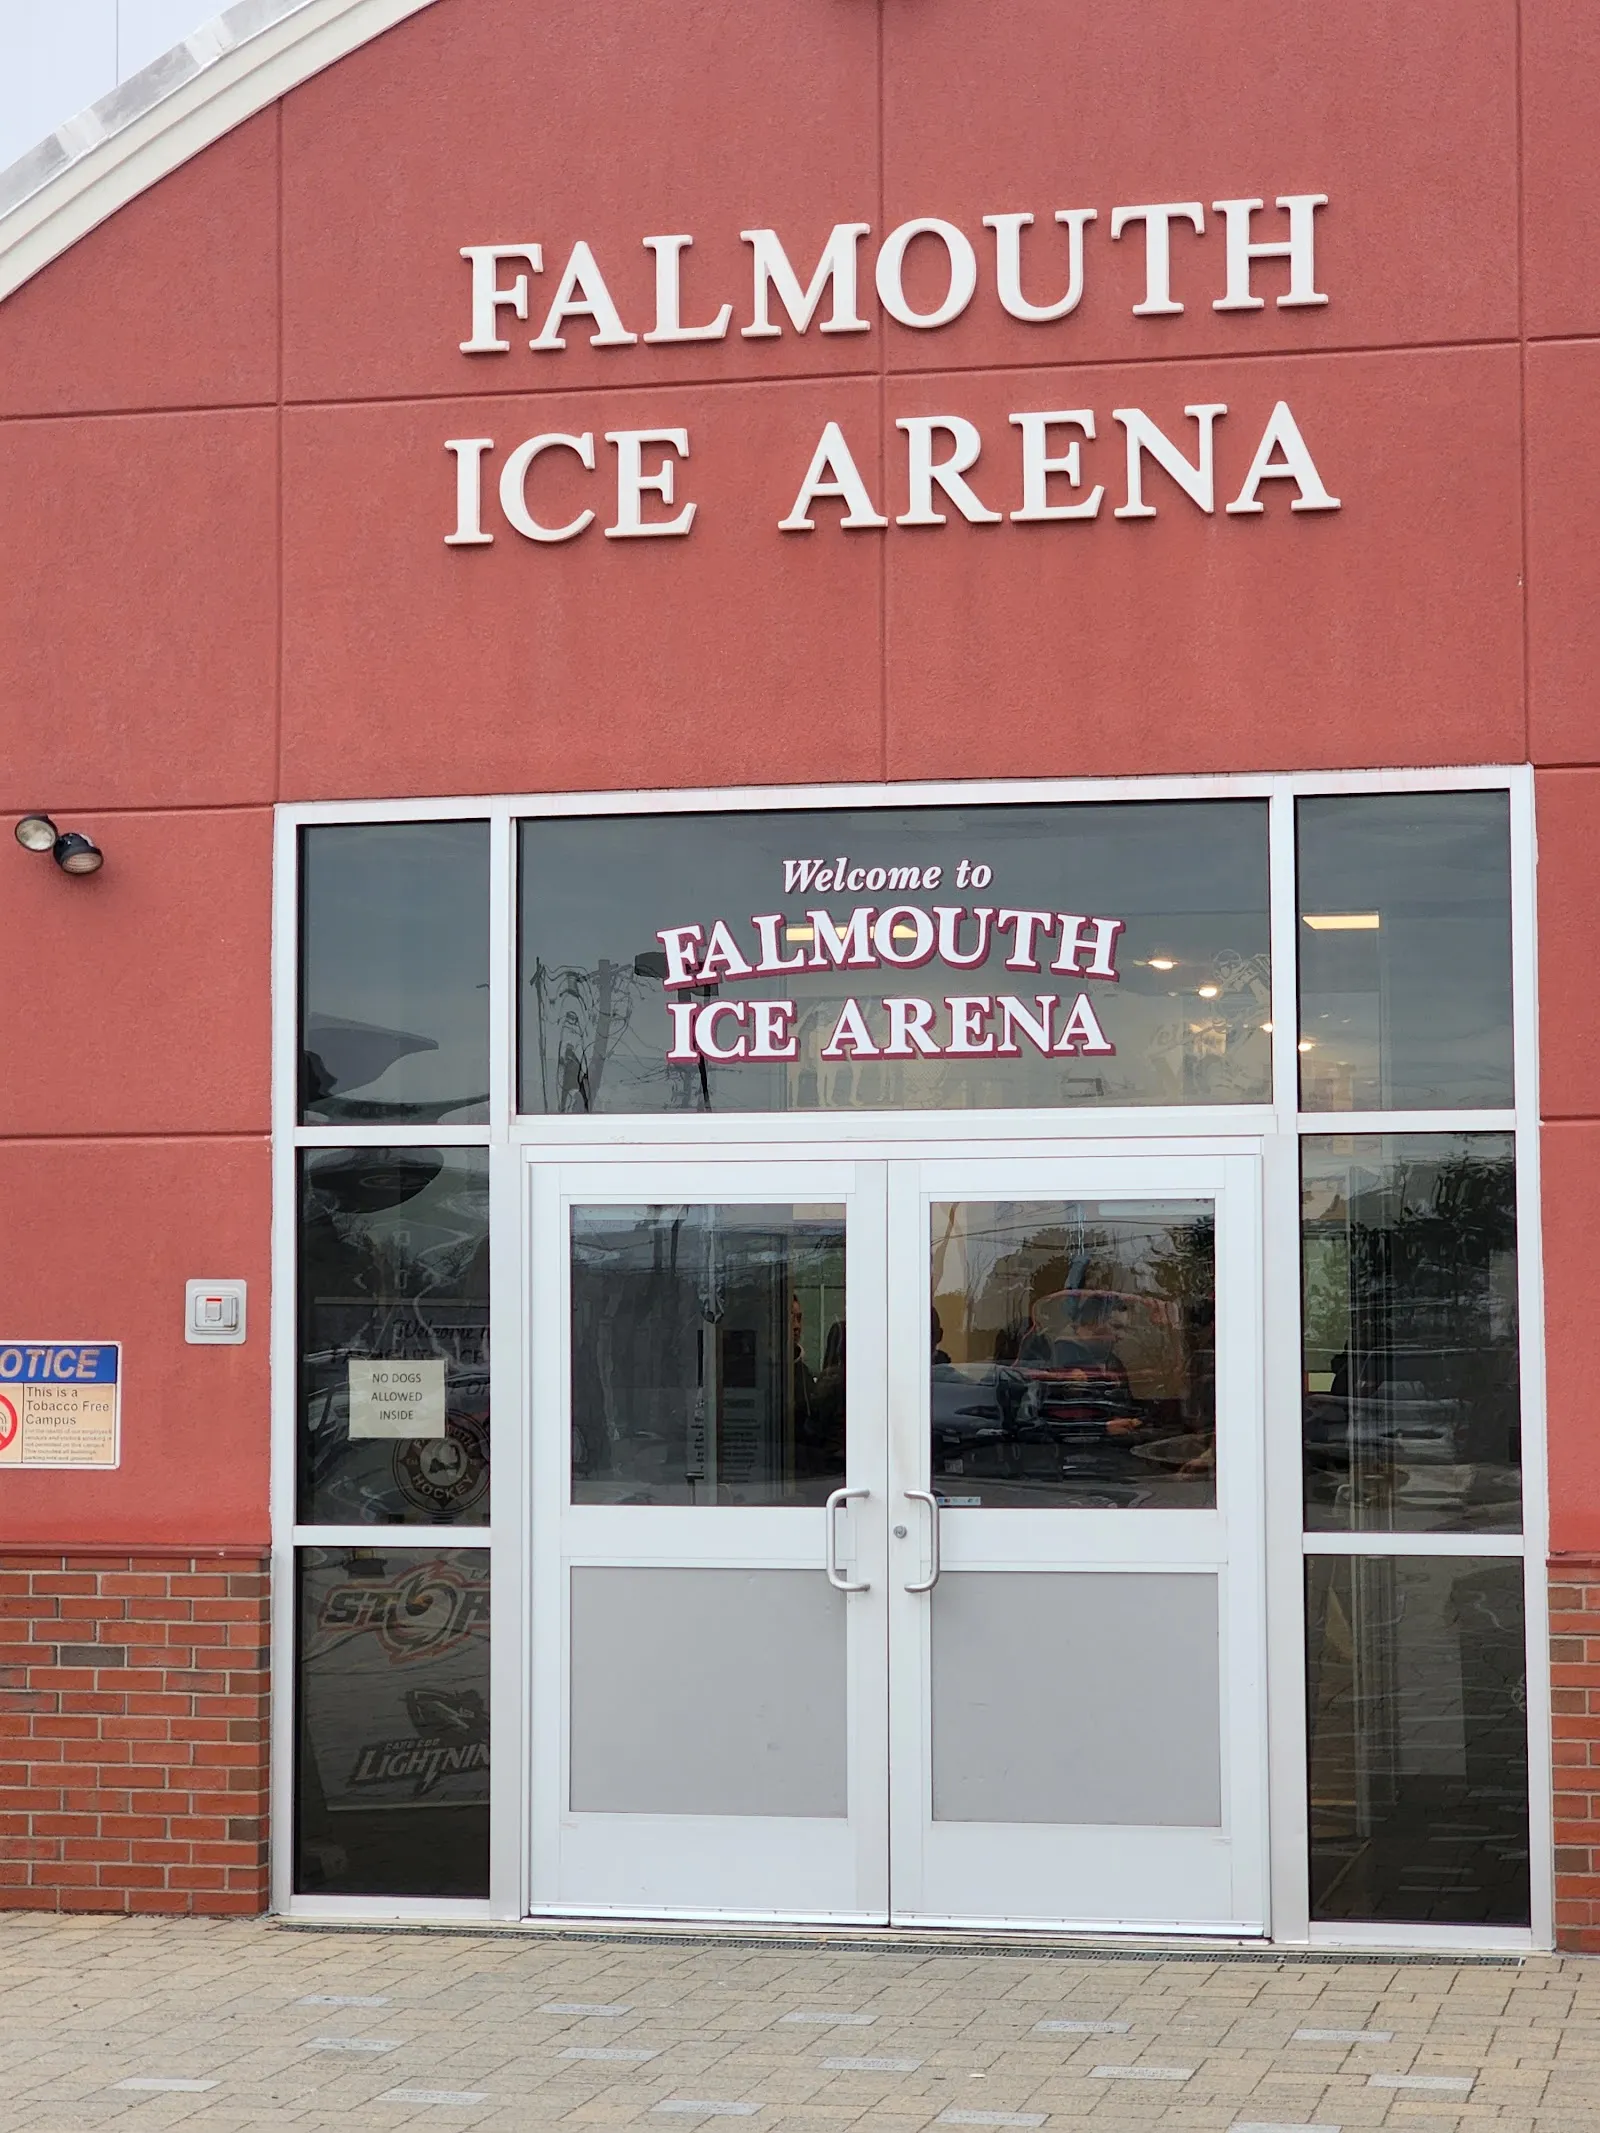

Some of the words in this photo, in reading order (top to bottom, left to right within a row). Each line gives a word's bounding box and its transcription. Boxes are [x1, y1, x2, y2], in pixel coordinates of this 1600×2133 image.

[459, 193, 1328, 354] FALMOUTH
[443, 427, 697, 545] ICE
[777, 400, 1341, 532] ARENA
[782, 857, 942, 893] Welcome
[955, 859, 993, 888] to
[656, 905, 1126, 991] FALMOUTH
[666, 1000, 798, 1063] ICE
[822, 993, 1116, 1059] ARENA
[372, 1373, 389, 1383] NO
[392, 1373, 422, 1383] DOGS
[27, 1387, 52, 1397] This
[56, 1387, 67, 1397] is
[71, 1389, 78, 1397] a
[371, 1392, 423, 1402] ALLOWED
[27, 1401, 78, 1412] Tobacco
[82, 1401, 110, 1412] Free
[380, 1410, 414, 1420] INSIDE
[26, 1414, 76, 1427] Campus
[412, 1475, 473, 1500] HOCKEY
